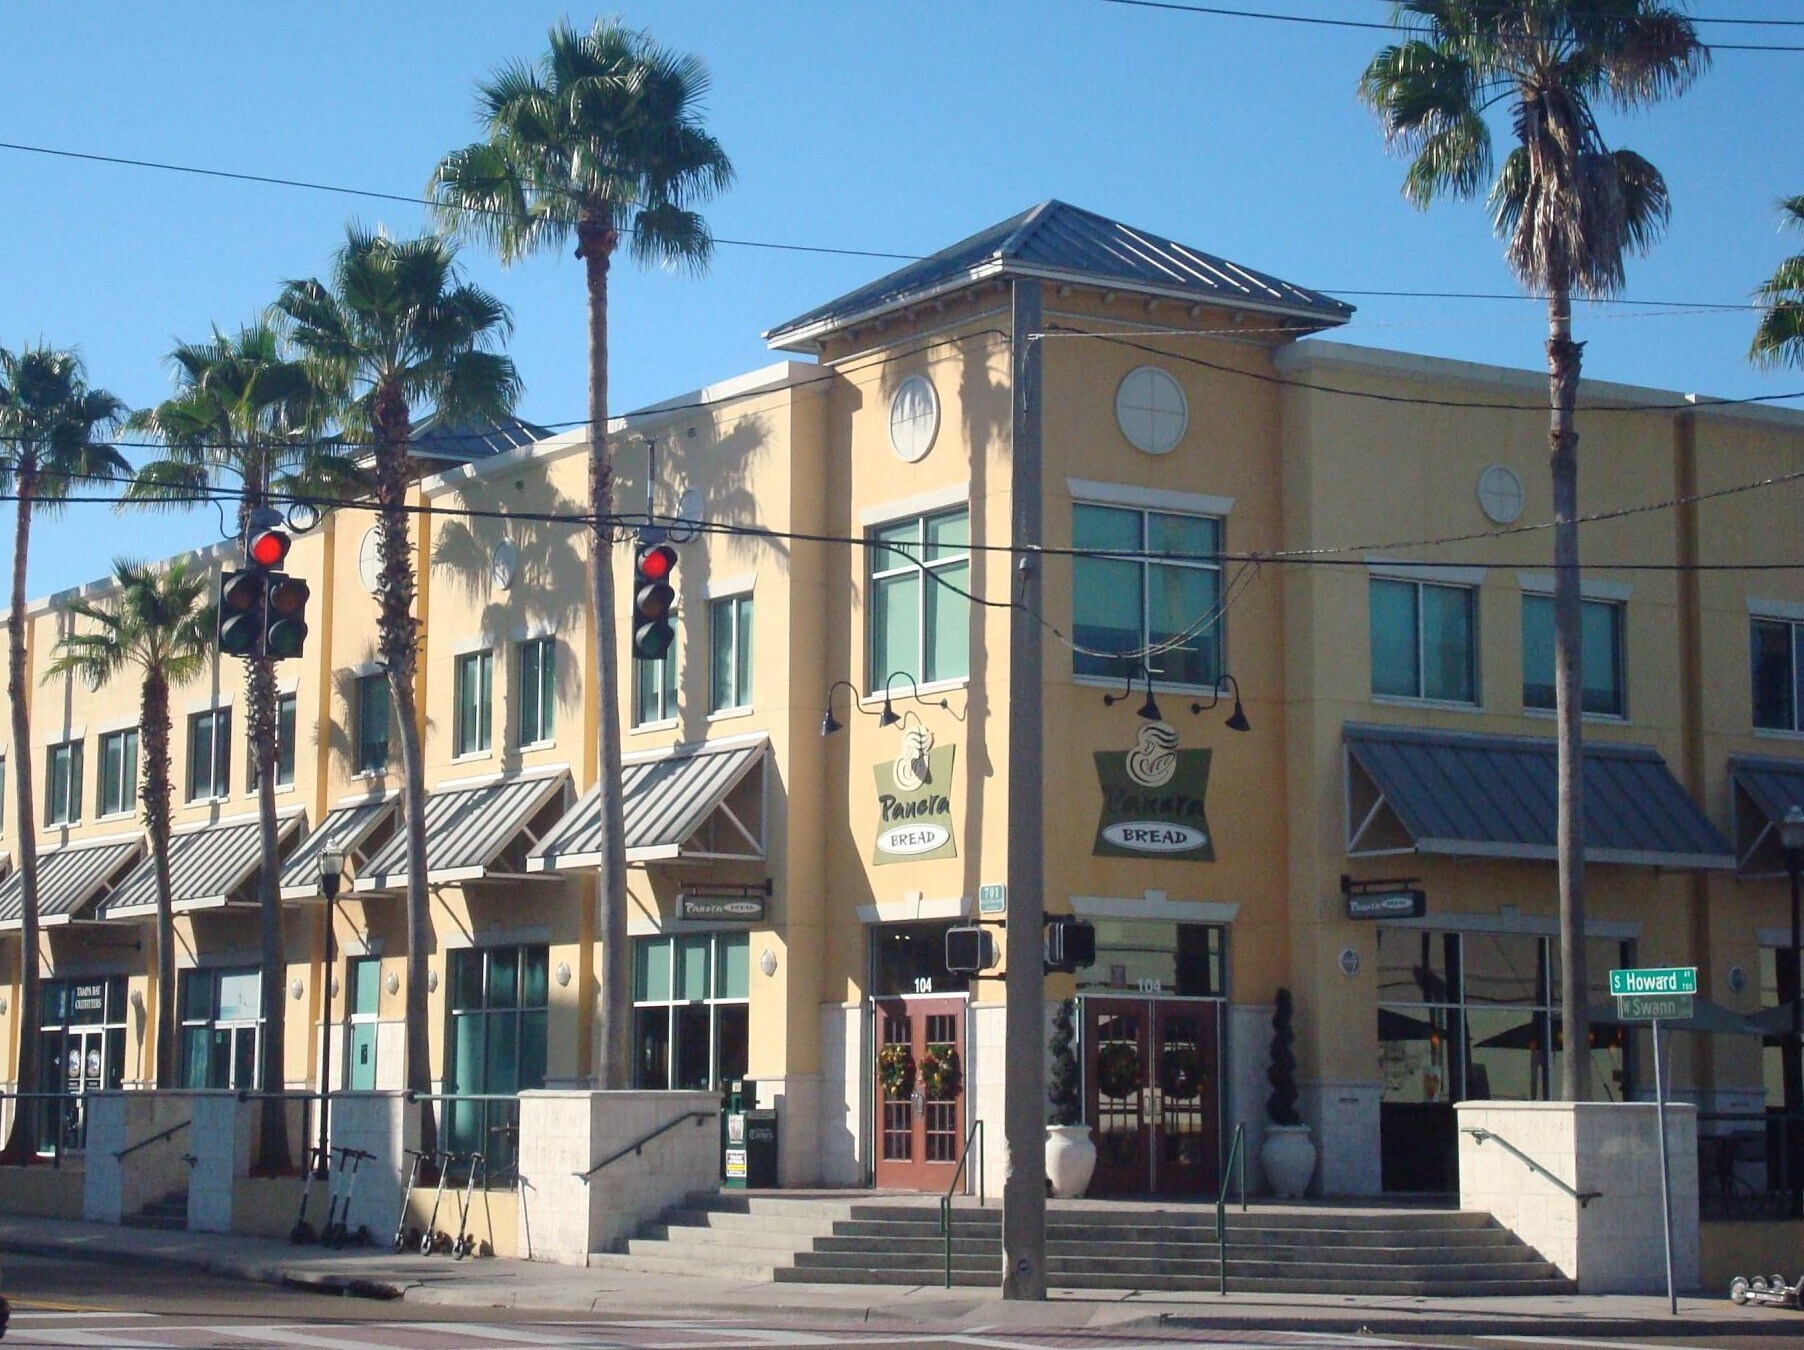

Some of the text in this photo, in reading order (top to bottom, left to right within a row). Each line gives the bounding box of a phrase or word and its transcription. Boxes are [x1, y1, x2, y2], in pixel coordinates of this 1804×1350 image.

[879, 793, 950, 823] Panera
[1107, 785, 1205, 817] Panera
[890, 831, 935, 847] BREAD
[1122, 828, 1188, 844] BREAD
[984, 886, 999, 898] 701
[914, 976, 932, 993] 104
[1137, 978, 1161, 993] 104
[1614, 975, 1621, 989] S
[1626, 972, 1677, 991] Howard
[76, 985, 91, 997] TAMPA
[1633, 998, 1676, 1016] Swann
